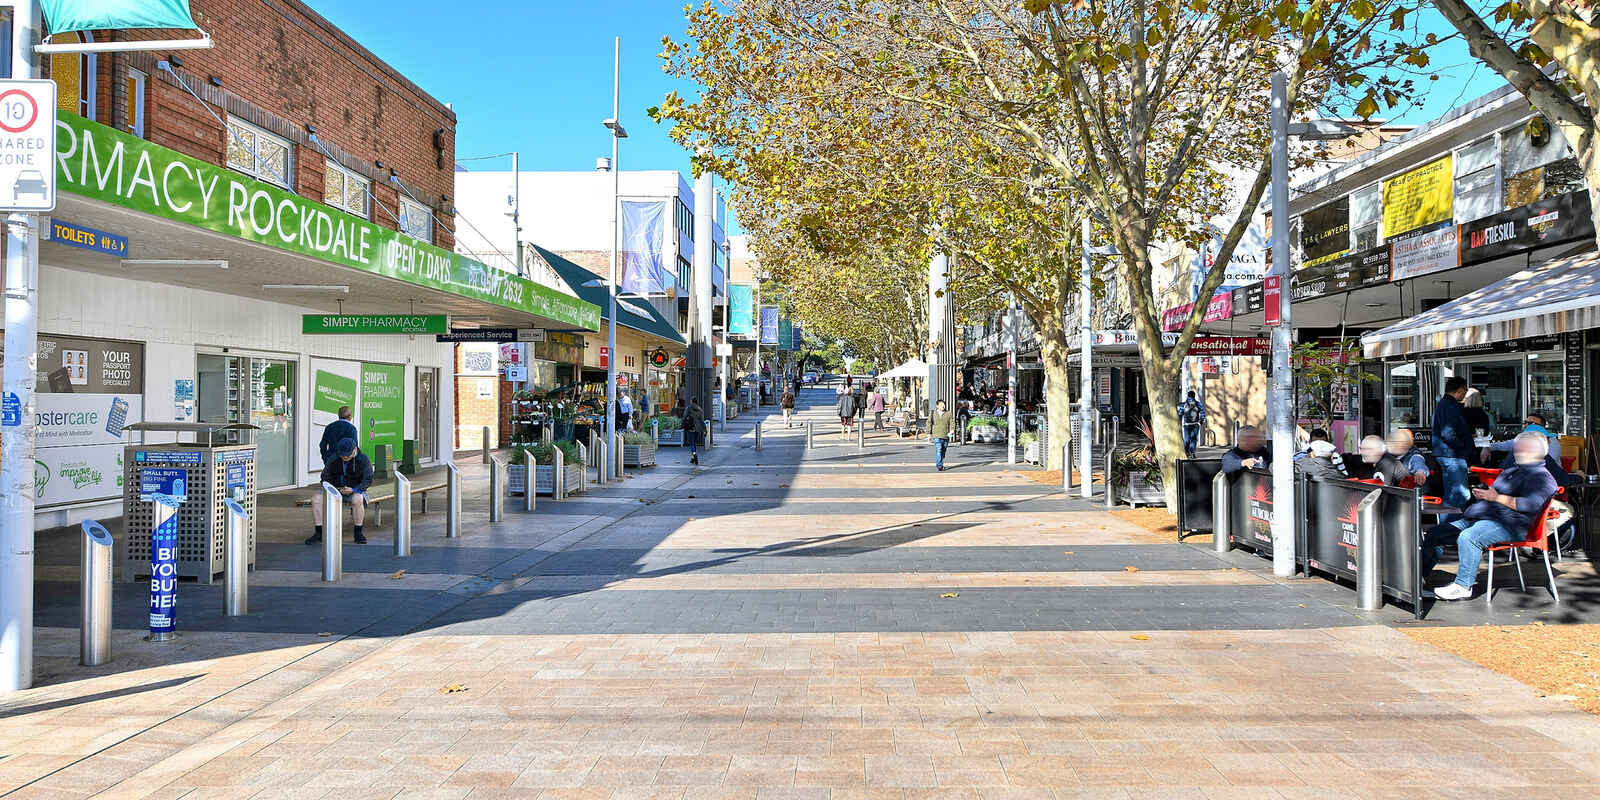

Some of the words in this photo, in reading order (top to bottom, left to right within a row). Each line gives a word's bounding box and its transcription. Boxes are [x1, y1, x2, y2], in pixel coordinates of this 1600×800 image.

[5, 101, 25, 120] 10
[1416, 163, 1444, 178] PRACTICE
[228, 181, 370, 264] ROCKDALE
[54, 224, 96, 246] TOILETS
[1320, 223, 1349, 240] LAWYERS
[387, 239, 416, 274] OPEN
[419, 249, 425, 277] 7
[427, 253, 451, 284] DAYS
[480, 270, 501, 298] 9507
[503, 280, 524, 305] 2632
[1268, 279, 1276, 287] NO
[322, 316, 360, 327] SIMPLY
[362, 316, 428, 328] PHARMACY
[486, 331, 513, 339] Service
[1191, 339, 1248, 349] ensational
[101, 350, 130, 363] YOUR
[103, 362, 131, 370] PASSPORT
[103, 370, 131, 379] PHOTO
[364, 372, 388, 384] SIMPLY
[364, 384, 401, 399] PHARMACY
[1342, 531, 1358, 546] AUR
